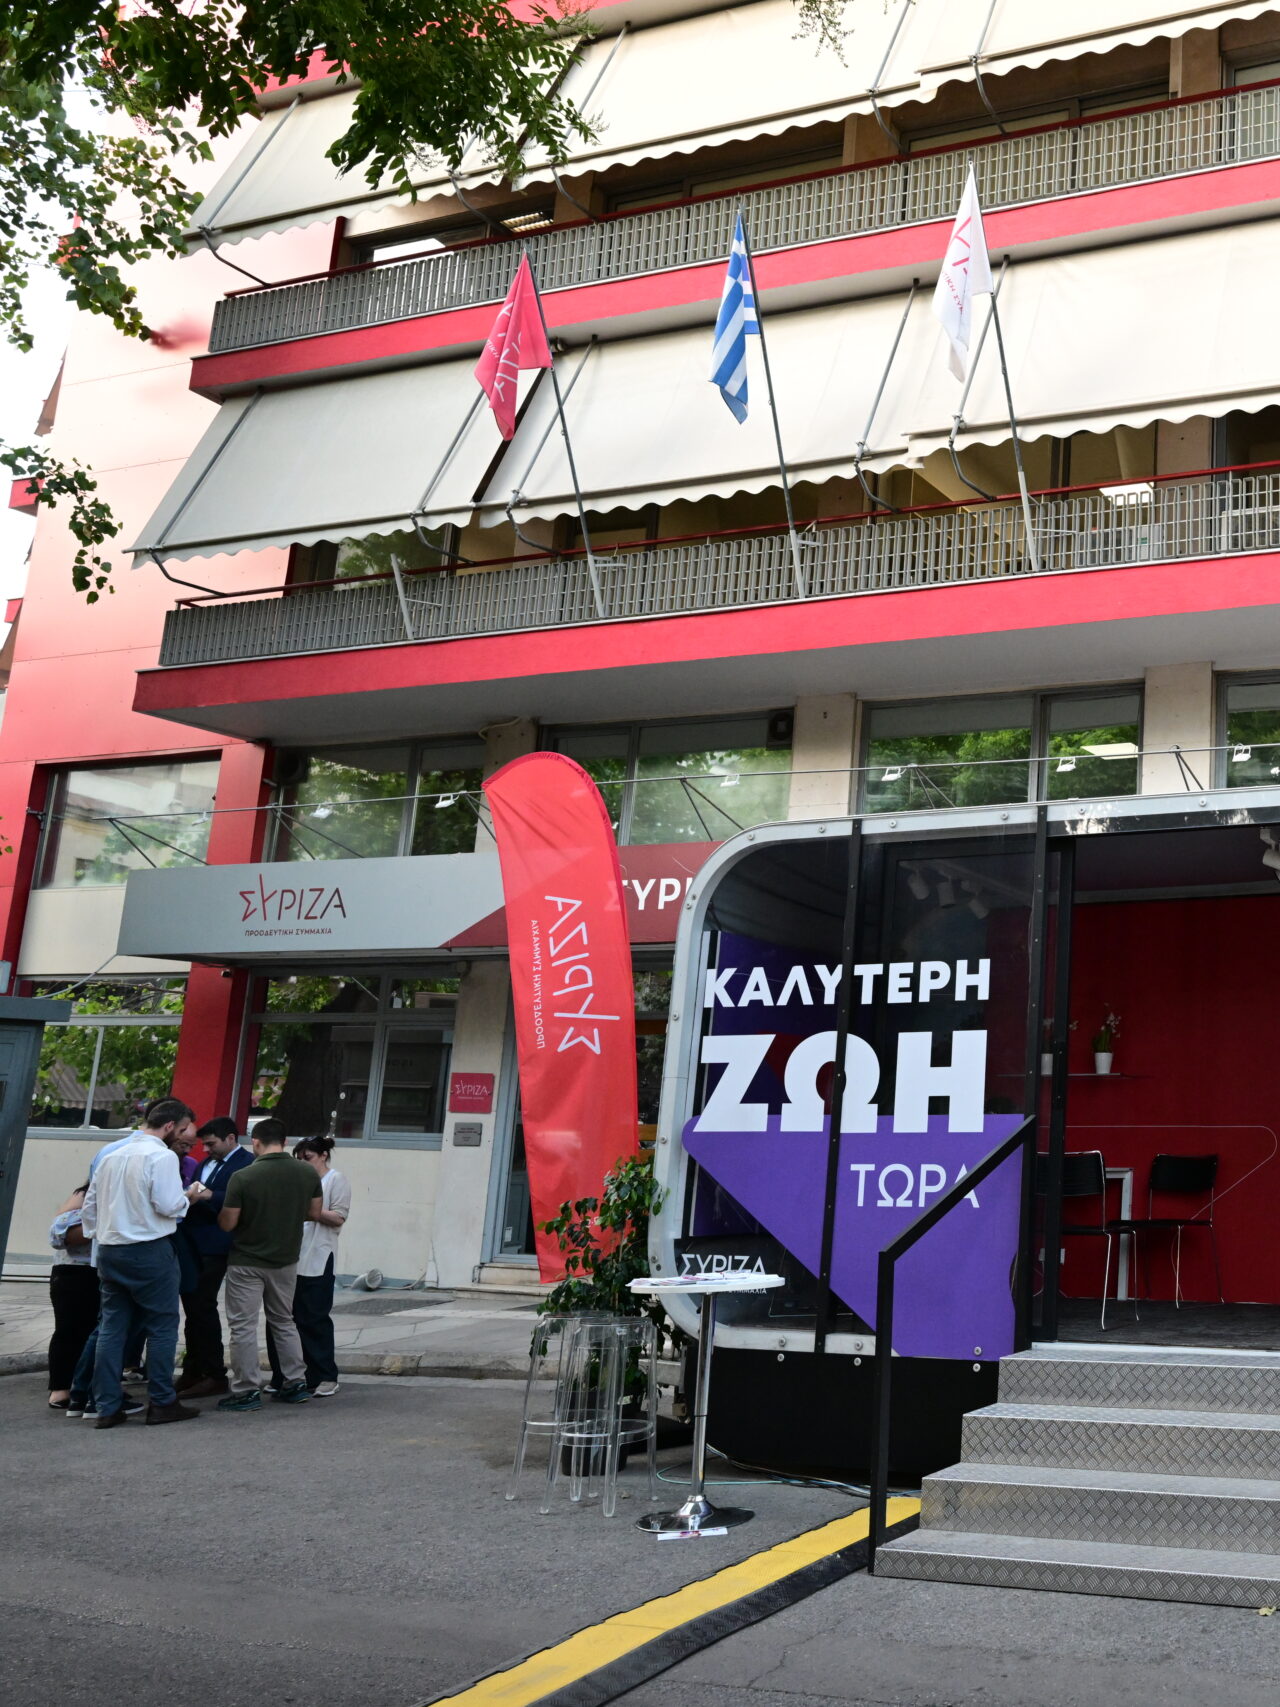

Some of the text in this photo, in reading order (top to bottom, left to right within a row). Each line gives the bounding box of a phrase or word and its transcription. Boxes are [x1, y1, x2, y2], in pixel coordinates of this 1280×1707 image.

[239, 873, 346, 922] ΣΥΡΙΖΑ
[244, 927, 332, 937] ΠΡΟΟΔΕΥΤΙΚΗ ΣΥΜΜΑΧΙΑ
[703, 958, 991, 1009] ΚΑΛΥΤΕΡΗ
[692, 1030, 988, 1134] ΖΩΗ
